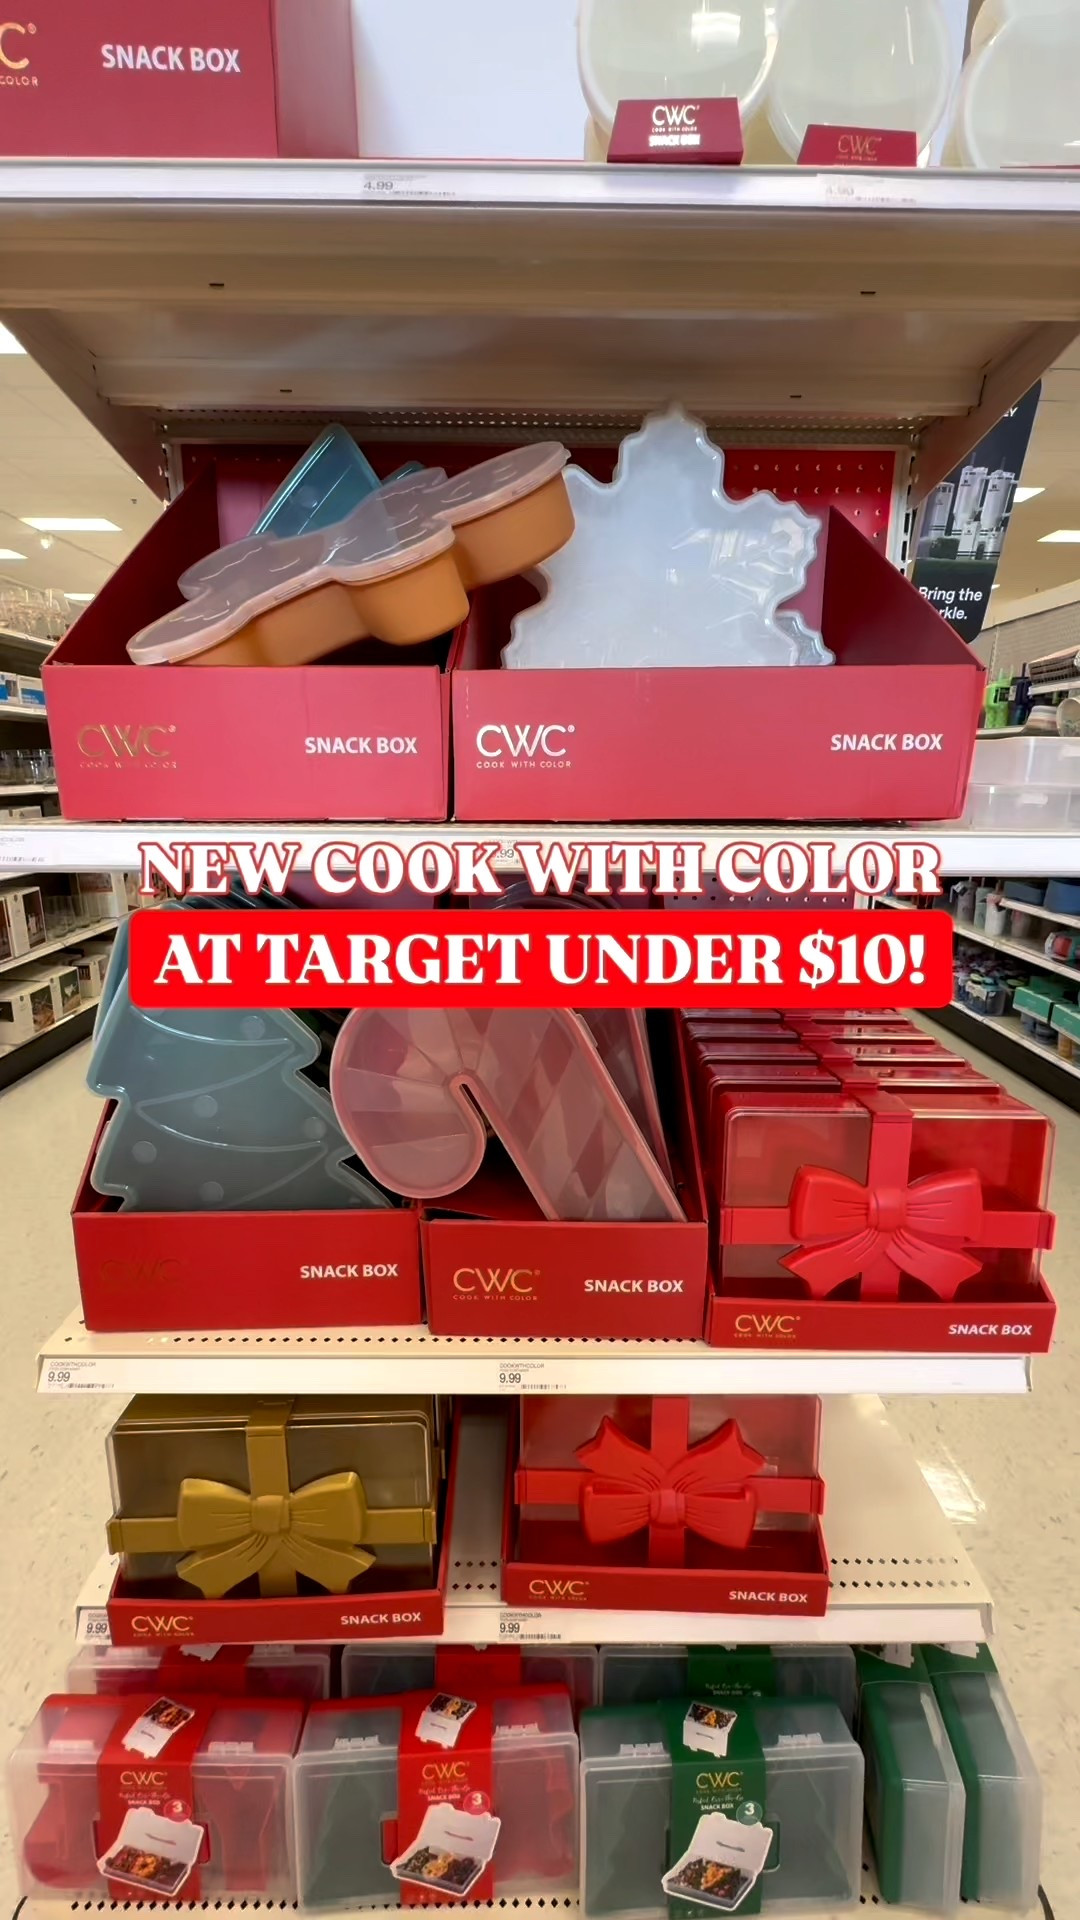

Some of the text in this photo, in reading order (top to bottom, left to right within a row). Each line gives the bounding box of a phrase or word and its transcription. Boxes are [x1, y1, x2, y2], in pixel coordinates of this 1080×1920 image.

[101, 44, 241, 73] SNACK BOX
[652, 104, 696, 126] CWC
[838, 134, 877, 155] CWC
[363, 181, 394, 190] 4.99
[919, 586, 983, 604] Bring the
[939, 606, 967, 620] rkle.
[77, 724, 170, 757] CWC
[304, 737, 418, 754] SNACK BOX
[476, 724, 567, 757] CWC
[830, 733, 943, 751] SNACK BOX
[476, 761, 572, 769] COOK WITH COLOR
[496, 848, 515, 859] .99
[300, 1263, 398, 1279] SNACK BOX
[453, 1268, 533, 1292] CWC
[584, 1279, 684, 1293] SNACK BOX
[735, 1314, 795, 1332] CWC
[948, 1324, 1033, 1336] SNACK BOX
[48, 1371, 71, 1383] 9.99
[499, 1372, 521, 1384] 9.99
[529, 1579, 585, 1596] CWC
[729, 1590, 808, 1603] SNACK BOX
[131, 1615, 190, 1632] CWC
[340, 1612, 422, 1625] SNACK BOX
[86, 1622, 107, 1634] 9.99
[500, 1622, 520, 1634] 9.99
[120, 1771, 165, 1786] CWC
[421, 1762, 466, 1780] CWC
[696, 1771, 740, 1789] CWC
[172, 1801, 183, 1813] 3
[472, 1793, 482, 1806] 3
[744, 1802, 755, 1815] 3
